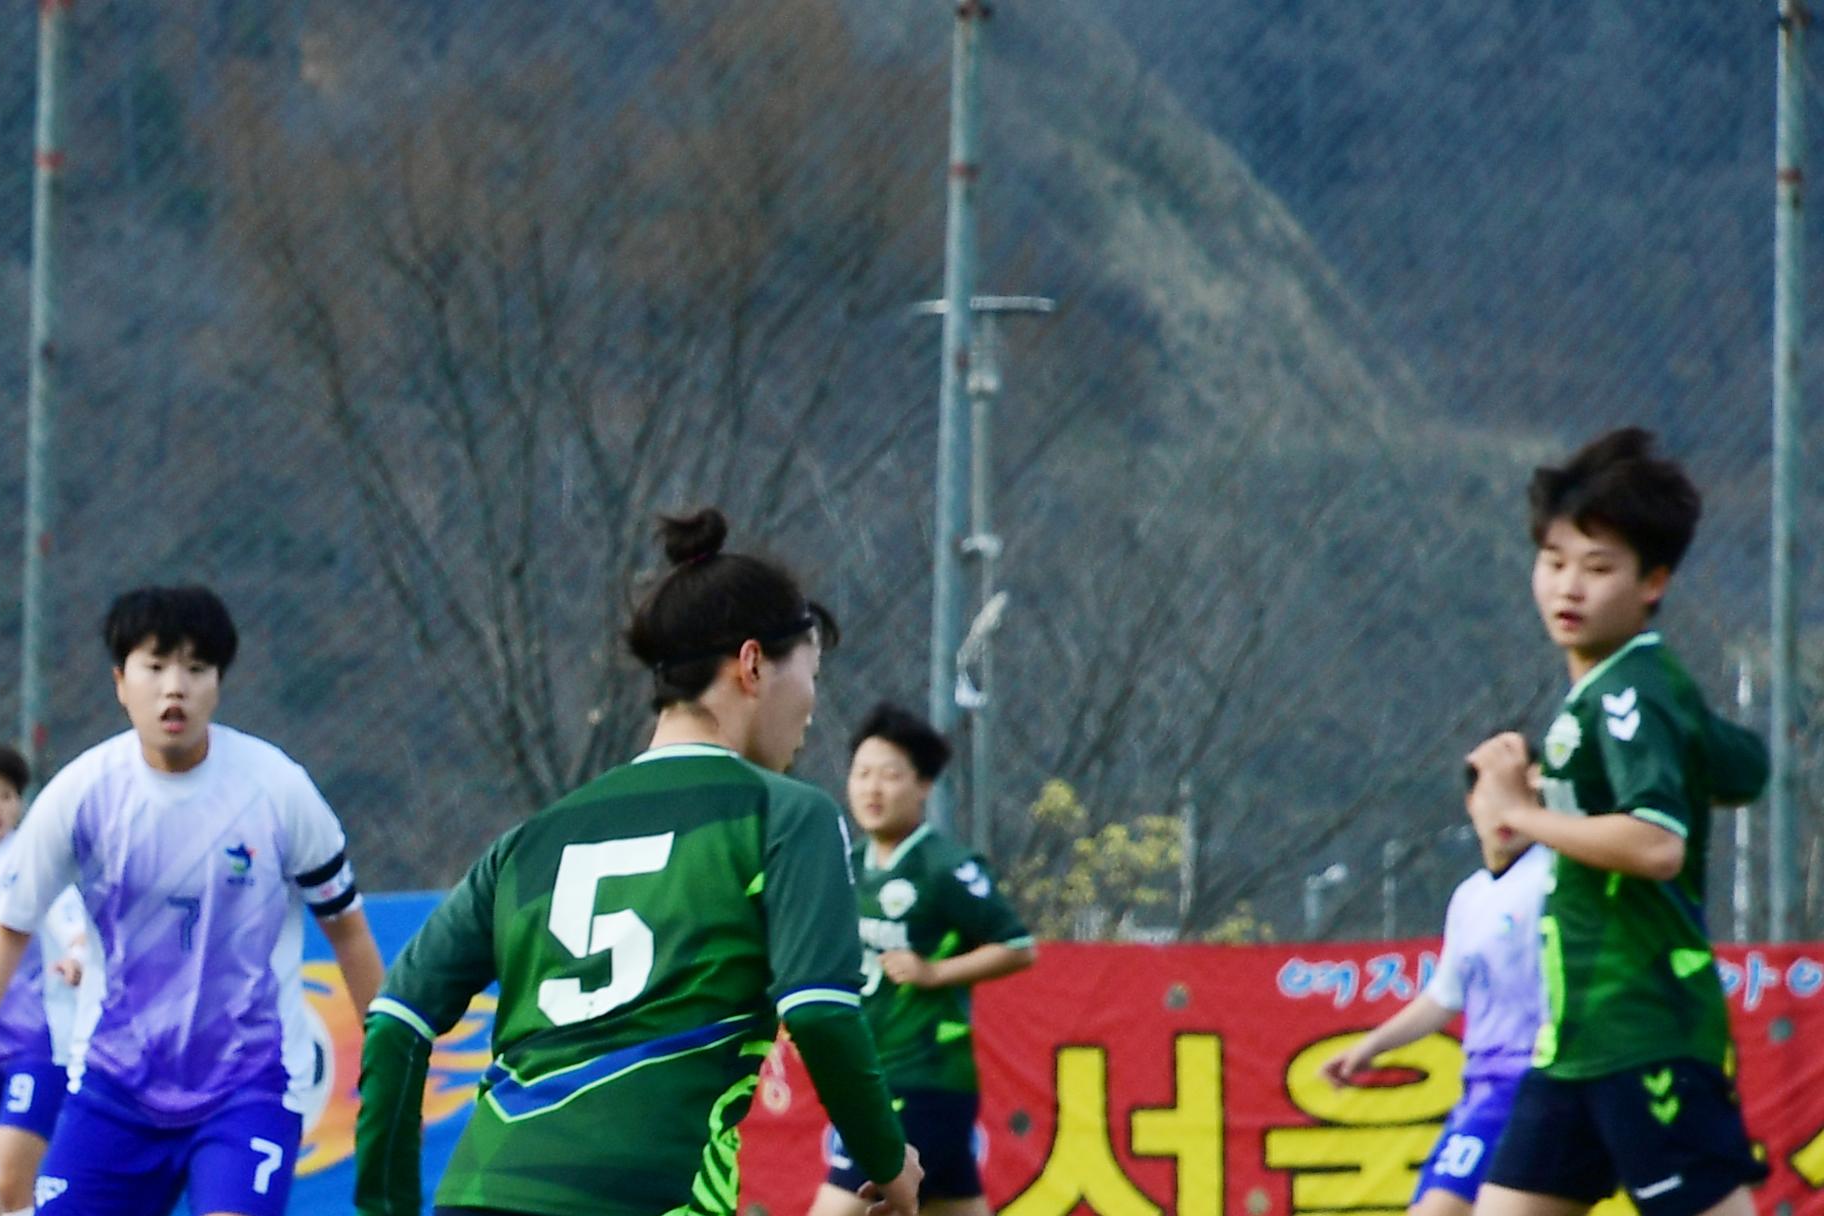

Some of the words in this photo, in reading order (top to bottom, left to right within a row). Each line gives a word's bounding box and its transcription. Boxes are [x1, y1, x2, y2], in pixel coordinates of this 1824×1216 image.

[166, 896, 201, 951] 7
[538, 831, 674, 1027] 5
[6, 1073, 35, 1113] 9
[250, 1137, 282, 1194] 7
